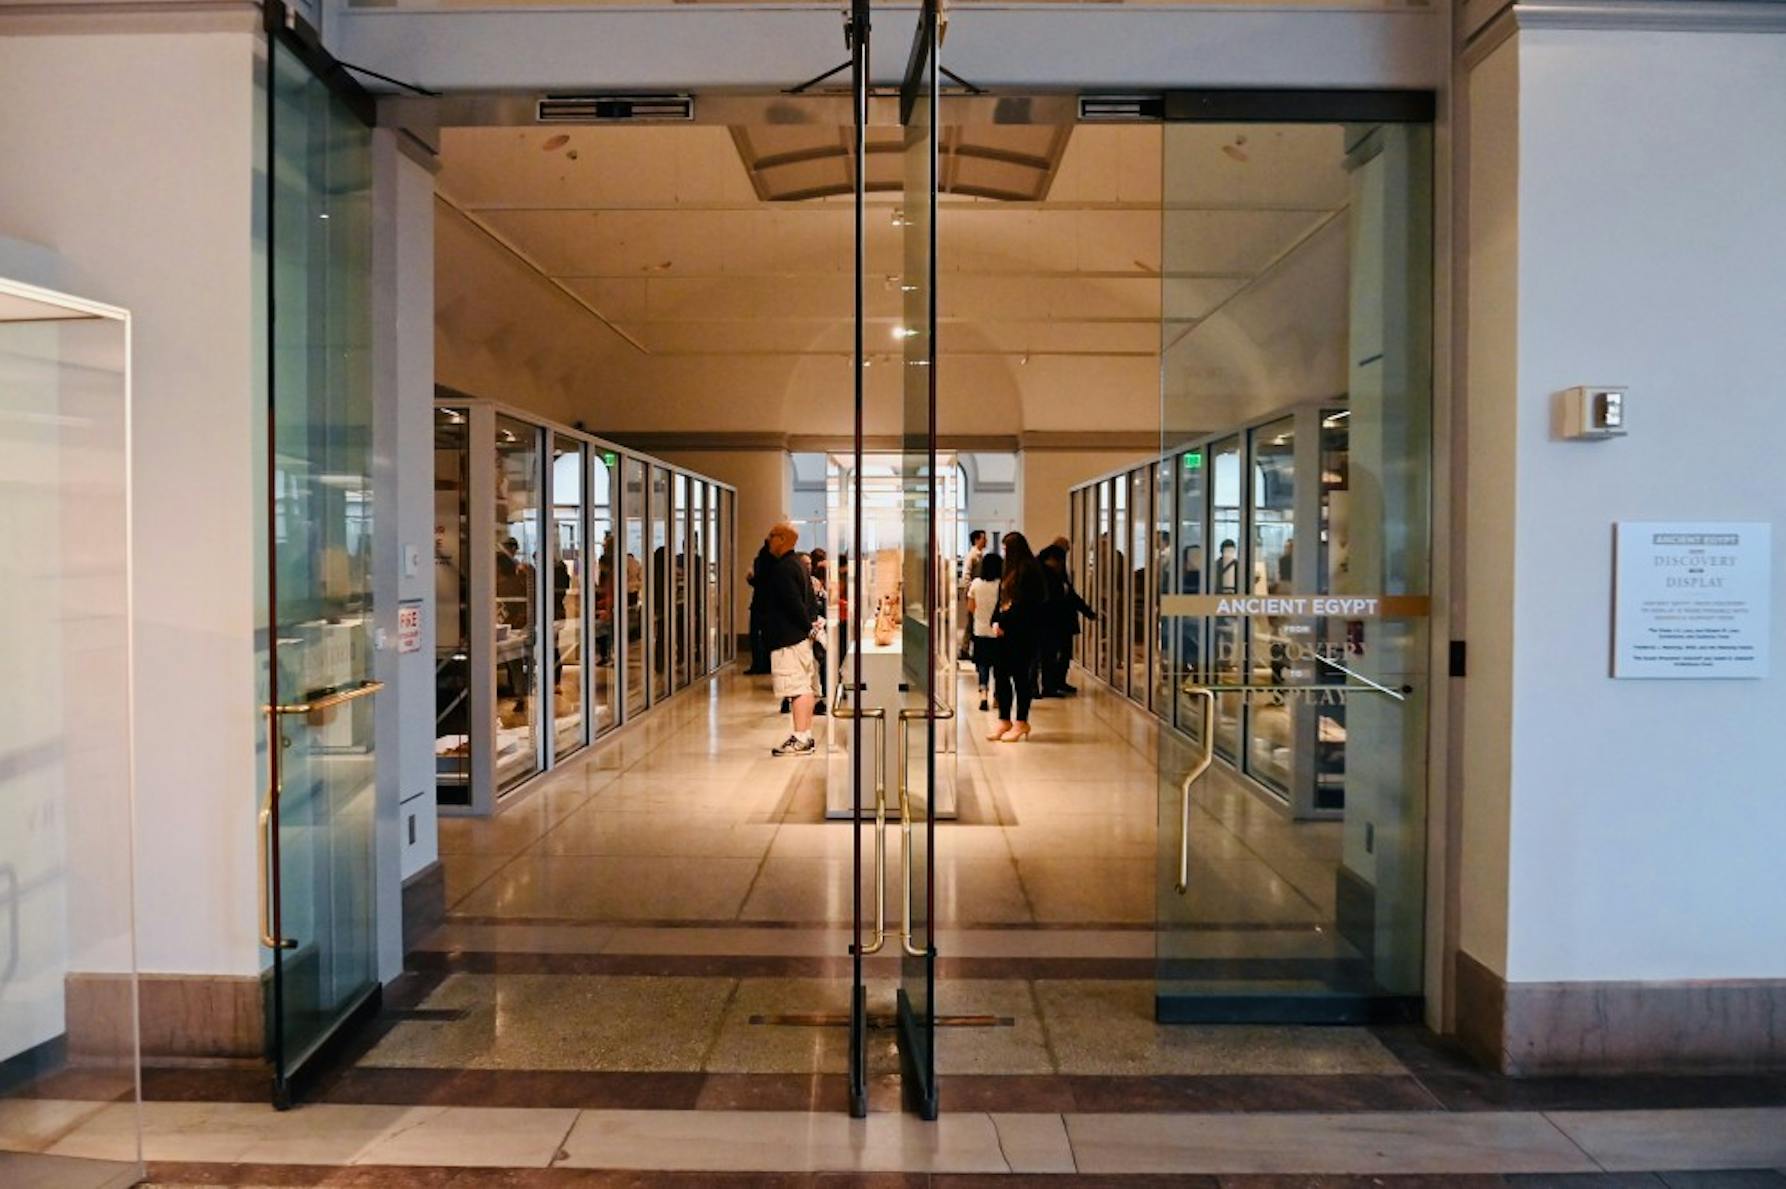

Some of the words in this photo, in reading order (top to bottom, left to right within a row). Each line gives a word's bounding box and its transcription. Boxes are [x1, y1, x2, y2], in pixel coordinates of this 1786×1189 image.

[1654, 556, 1738, 566] DISCOVERY
[1666, 577, 1726, 588] DISPLAY
[1216, 598, 1307, 614] ANCIENT
[1312, 598, 1378, 614] EGYPT
[1283, 625, 1311, 633] FROM
[1217, 641, 1368, 661] DICOVERY
